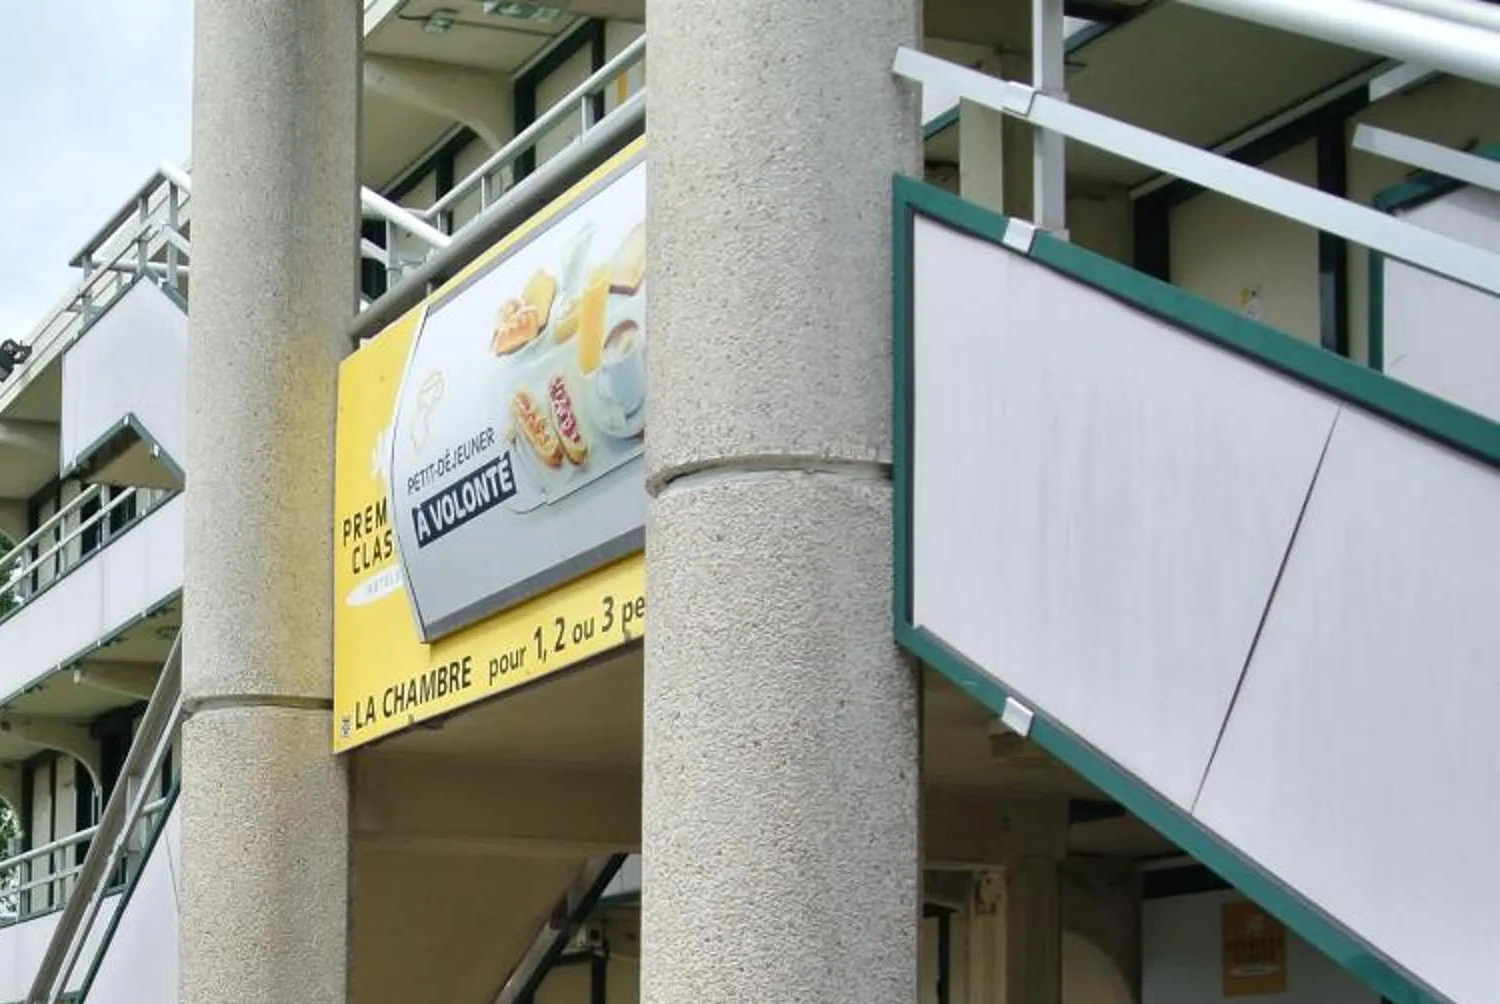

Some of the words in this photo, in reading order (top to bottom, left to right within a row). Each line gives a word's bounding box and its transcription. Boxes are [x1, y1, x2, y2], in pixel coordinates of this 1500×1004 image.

[408, 427, 495, 496] PETIT-DÉJEUNER
[429, 456, 514, 531] VOLONTÉ
[355, 695, 376, 730] LA
[383, 655, 472, 718] CHAMBRE
[488, 645, 527, 687] pour
[533, 625, 548, 662] 1,
[554, 615, 566, 653] 2
[572, 615, 595, 644] ou
[601, 595, 614, 633] 3
